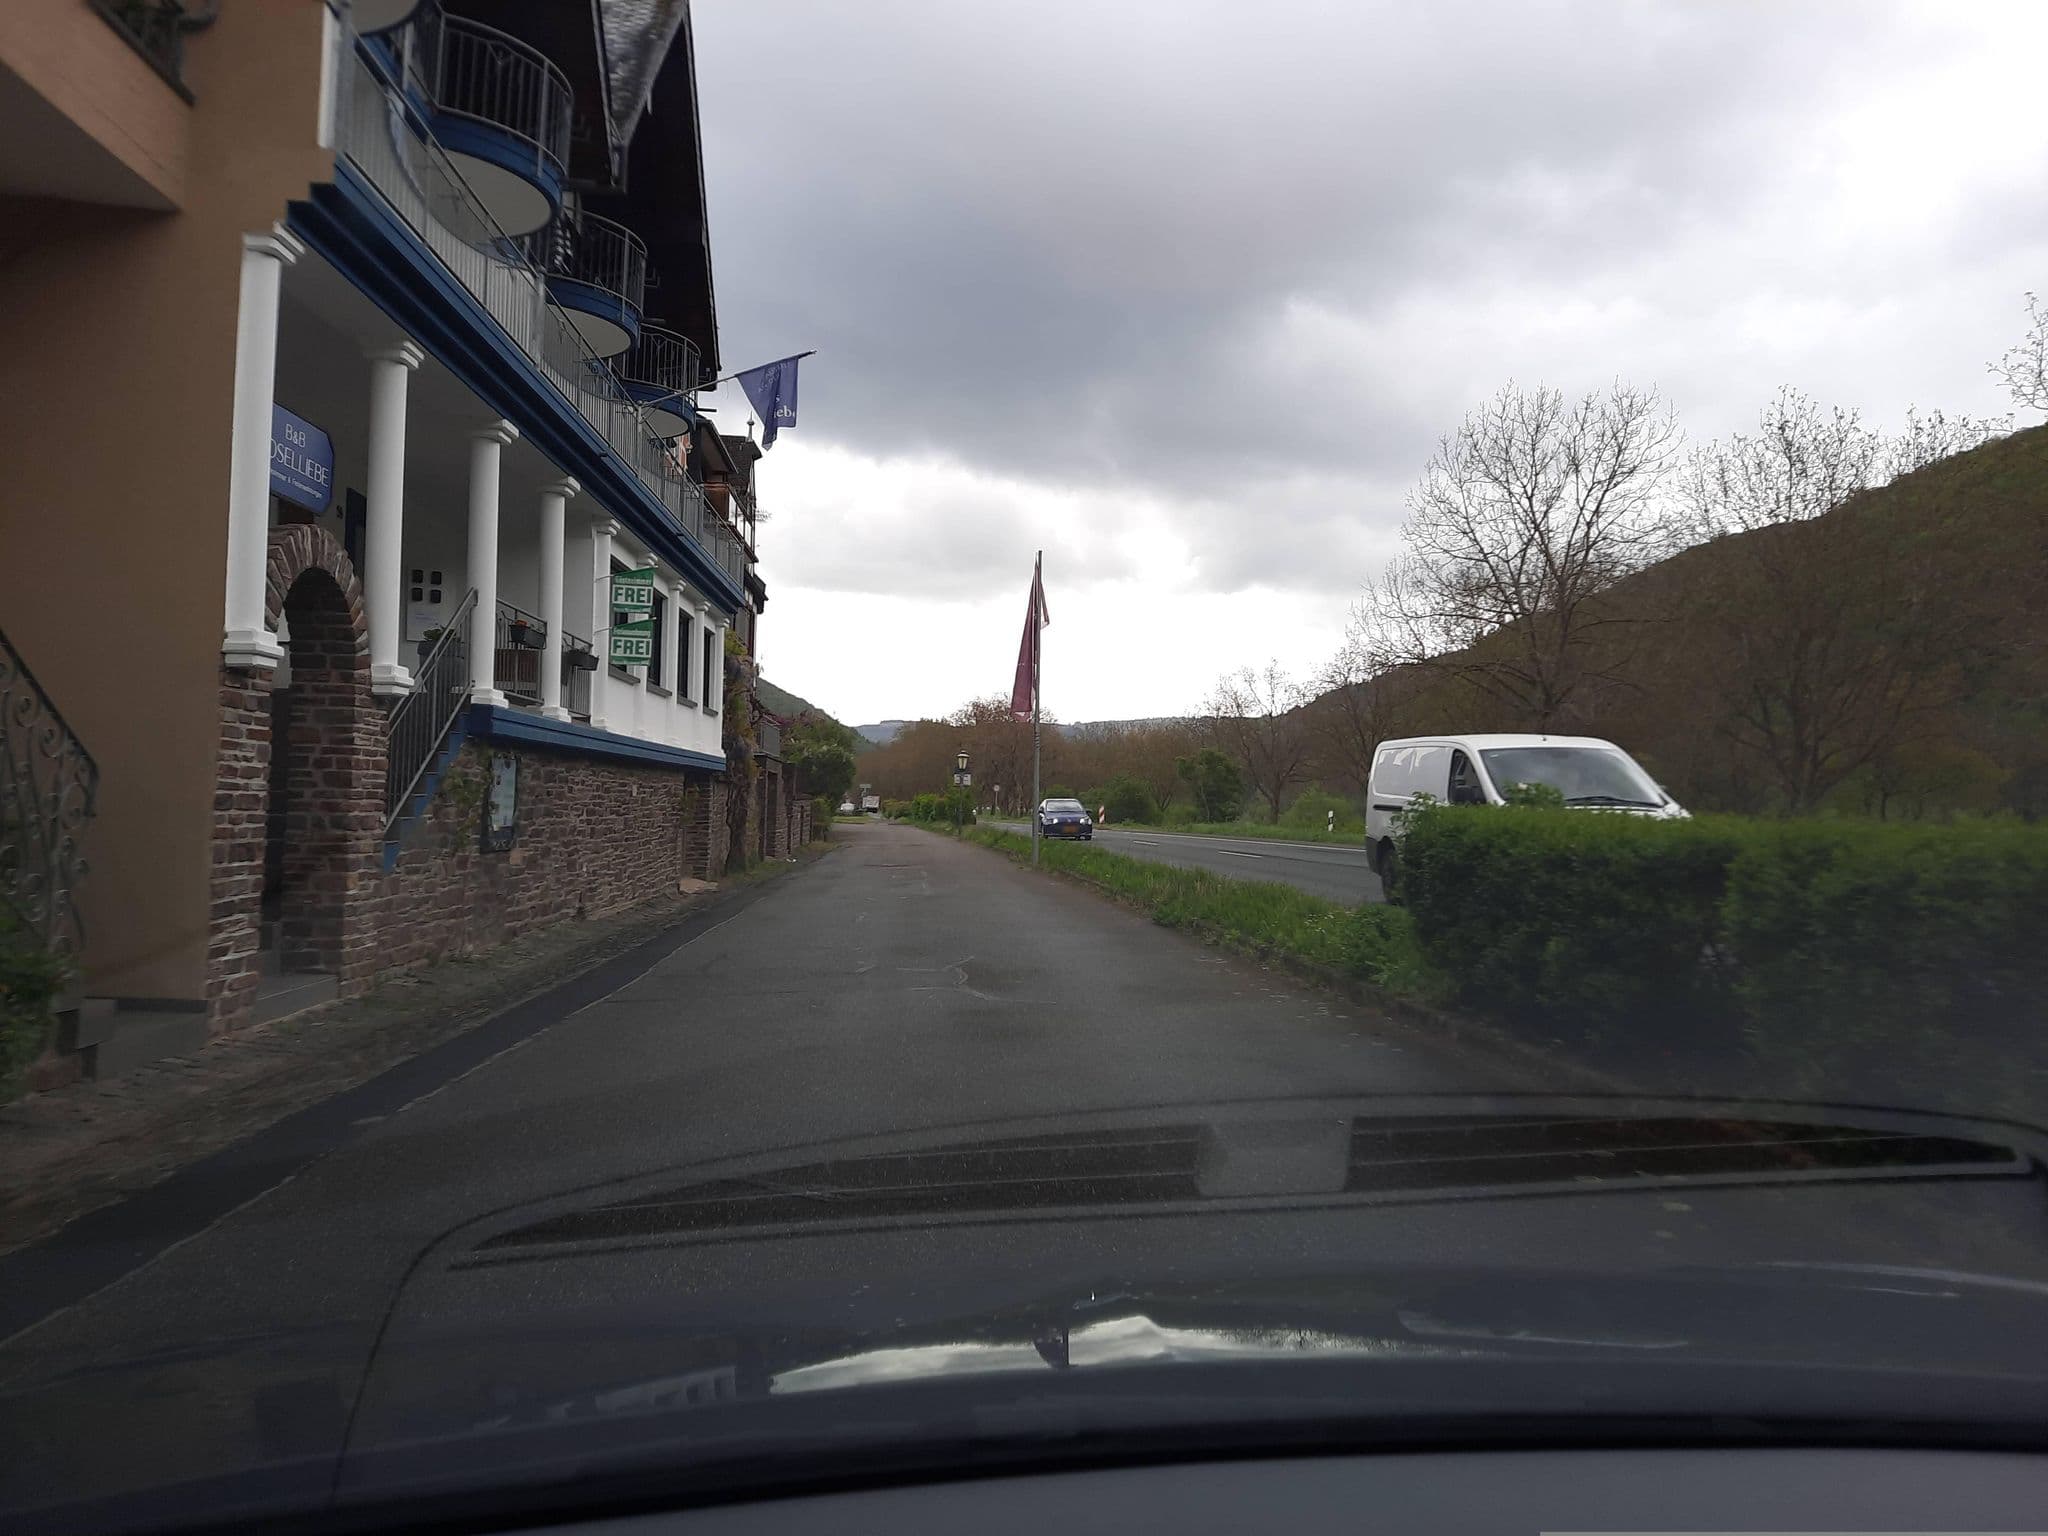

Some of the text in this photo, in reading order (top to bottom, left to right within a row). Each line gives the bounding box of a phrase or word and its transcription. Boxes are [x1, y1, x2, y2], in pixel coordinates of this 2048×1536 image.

[284, 423, 306, 448] B&B
[270, 438, 329, 488] OSELLIEBE
[614, 587, 652, 603] FREI
[613, 639, 650, 656] FREI
